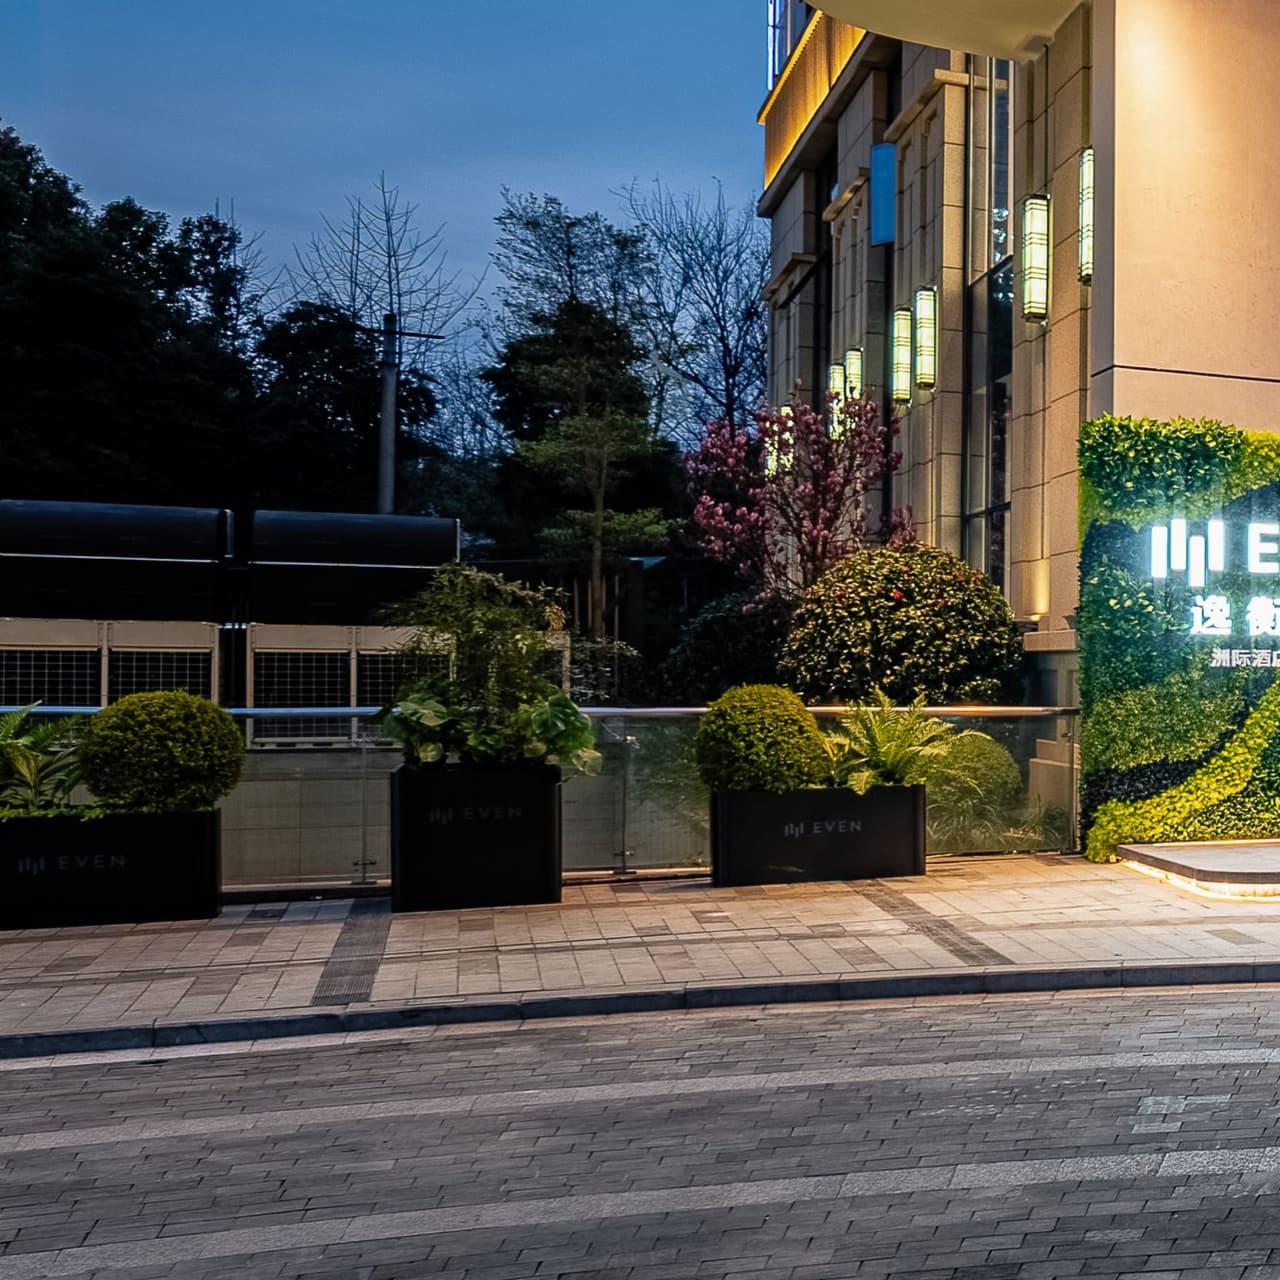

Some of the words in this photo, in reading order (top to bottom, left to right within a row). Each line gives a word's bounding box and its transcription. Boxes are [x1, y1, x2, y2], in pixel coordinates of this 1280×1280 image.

[463, 805, 523, 820] EVEN
[812, 819, 863, 834] EVEN
[57, 853, 127, 871] EVEN
